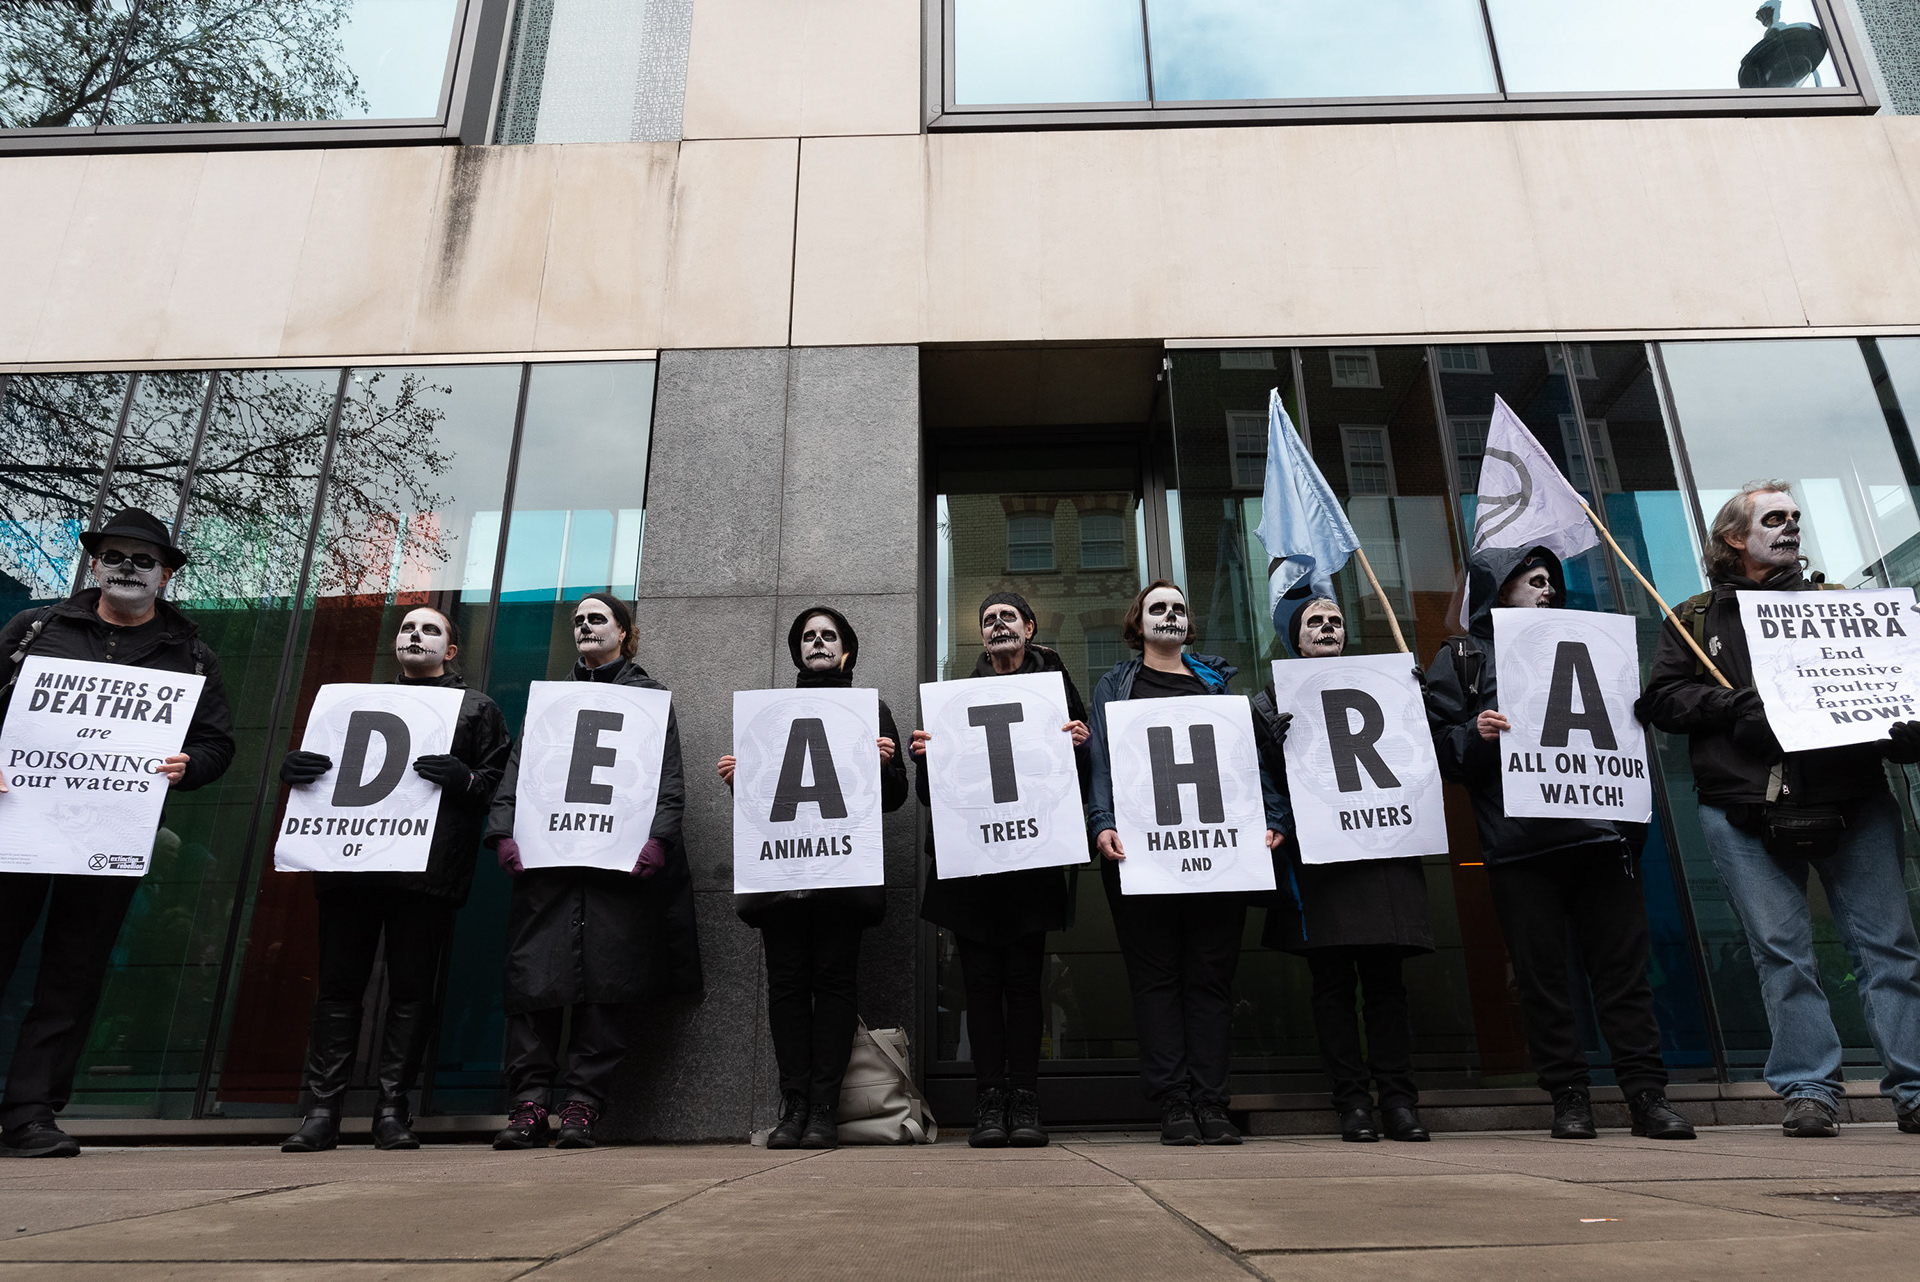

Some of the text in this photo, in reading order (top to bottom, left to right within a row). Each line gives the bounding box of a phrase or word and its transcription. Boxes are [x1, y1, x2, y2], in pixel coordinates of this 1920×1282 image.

[1757, 602, 1900, 617] MINISTERS OF
[1760, 618, 1907, 638] DEATHRA
[1821, 647, 1864, 659] End
[1797, 664, 1903, 677] intensive
[35, 673, 185, 702] MINISTERS OF
[1540, 641, 1618, 751] A
[1813, 681, 1897, 696] poultry
[29, 689, 172, 724] DEATHRA
[1816, 694, 1915, 710] farming
[1830, 704, 1916, 724] NOW!
[77, 728, 111, 739] are
[1321, 689, 1402, 793] R
[8, 749, 164, 775] POISONING
[331, 711, 410, 807] D
[564, 710, 624, 805] E
[968, 702, 1024, 804] T
[769, 718, 848, 823] A
[1147, 724, 1225, 826] H
[1508, 753, 1645, 779] ALL ON YOUR
[12, 774, 149, 792] our waters
[1540, 783, 1624, 807] WATCH!
[285, 817, 428, 836] DESTRUCTION
[549, 813, 614, 833] EARTH
[1339, 805, 1412, 830] RIVERS
[980, 818, 1038, 844] TREES
[1147, 829, 1238, 851] HABITAT
[343, 843, 362, 856] OF
[760, 835, 852, 860] ANIMALS
[1182, 858, 1212, 872] AND
